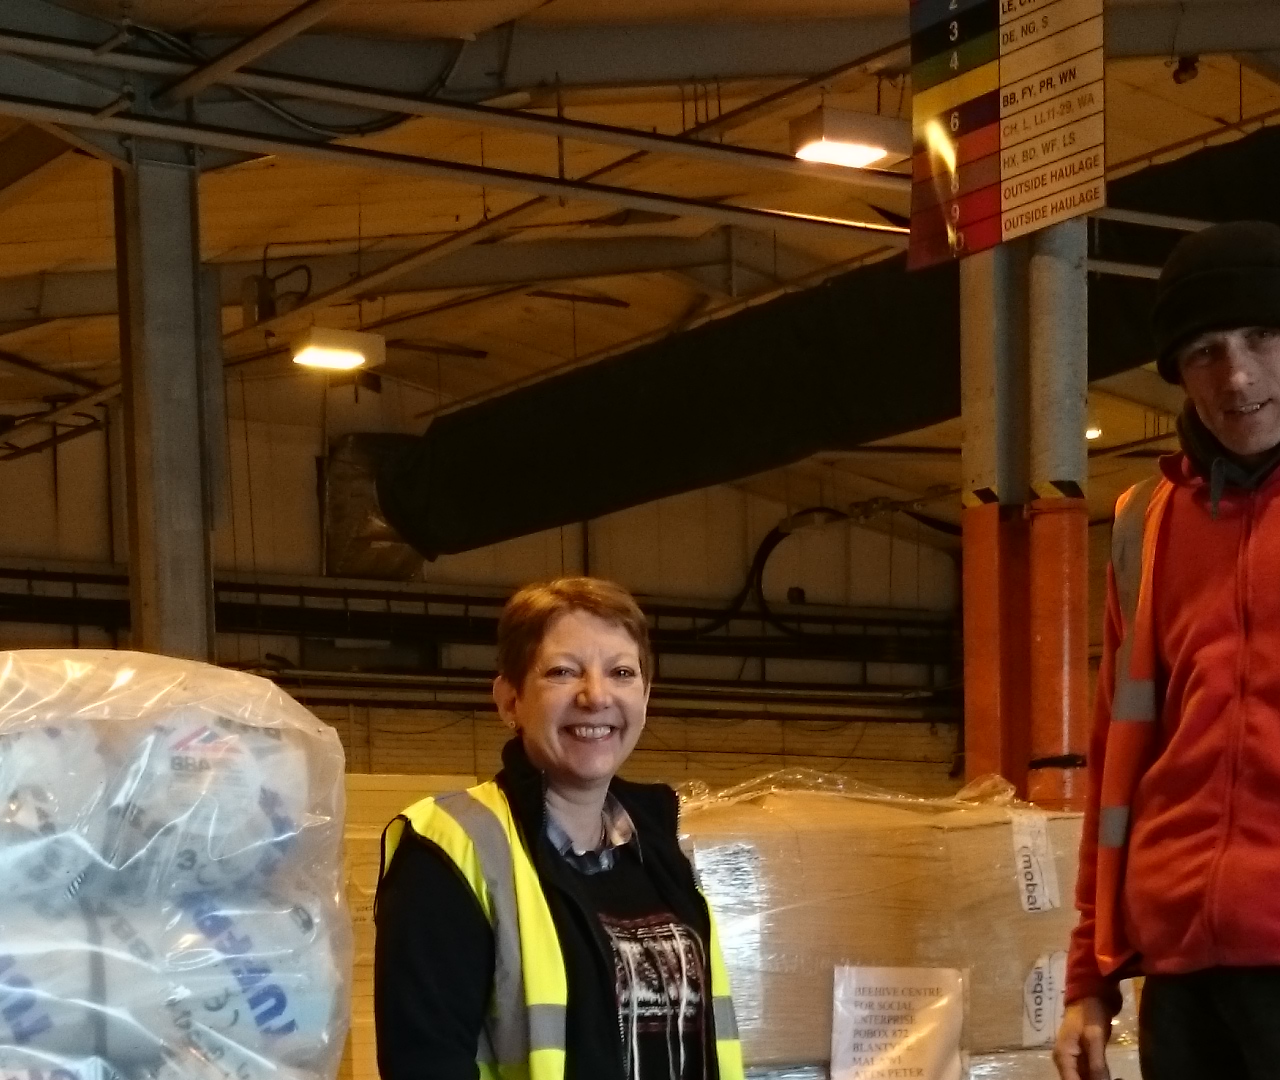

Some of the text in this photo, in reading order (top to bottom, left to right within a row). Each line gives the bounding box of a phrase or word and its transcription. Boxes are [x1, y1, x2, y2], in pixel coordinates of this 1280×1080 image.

[948, 21, 959, 41] 3
[948, 51, 958, 70] 4
[1041, 16, 1049, 28] S
[950, 111, 959, 132] 6
[1058, 68, 1076, 85] WN
[1062, 131, 1075, 147] LS
[1002, 174, 1047, 200] OUTSIDE
[1050, 154, 1099, 183] HAULAGE
[1003, 206, 1048, 231] OUTSIDE
[1050, 187, 1100, 215] HAULAGE
[853, 986, 944, 997] BEEHIVE CENTRE
[853, 1001, 913, 1011] FOR SOCIAL
[852, 1014, 916, 1025] ENTERPRISE
[852, 1029, 888, 1039] POBOX
[887, 1068, 924, 1079] PETER
